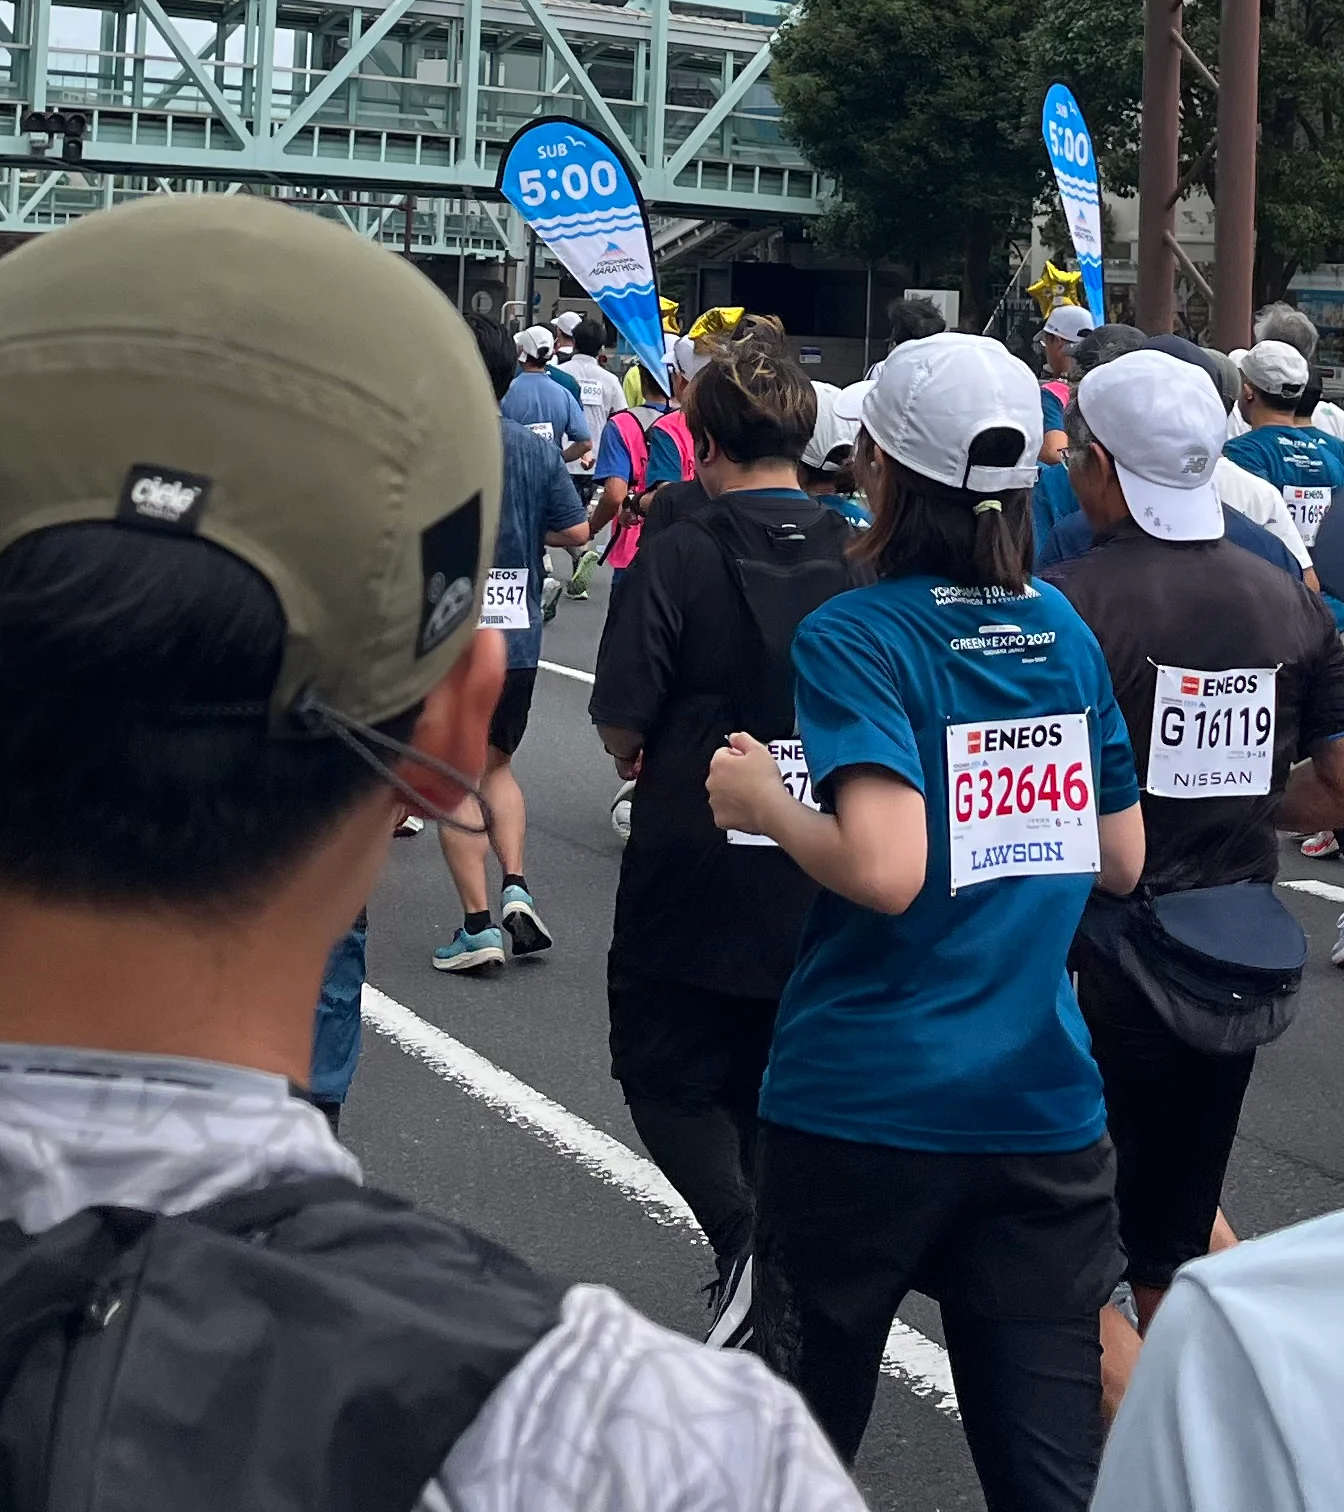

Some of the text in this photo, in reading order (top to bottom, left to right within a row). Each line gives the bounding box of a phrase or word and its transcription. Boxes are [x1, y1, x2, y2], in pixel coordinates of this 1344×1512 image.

[536, 141, 569, 160] SUB
[1048, 119, 1089, 168] 5:00
[518, 159, 618, 207] 5:00
[588, 263, 645, 277] MARATHON
[485, 585, 525, 606] 5547
[1026, 631, 1056, 646] 2027
[1202, 674, 1258, 697] ENEOS
[984, 722, 1063, 752] ENEOS
[1173, 770, 1253, 787] NISSAN
[955, 761, 1089, 823] G32646
[970, 840, 1065, 871] LAWSON
